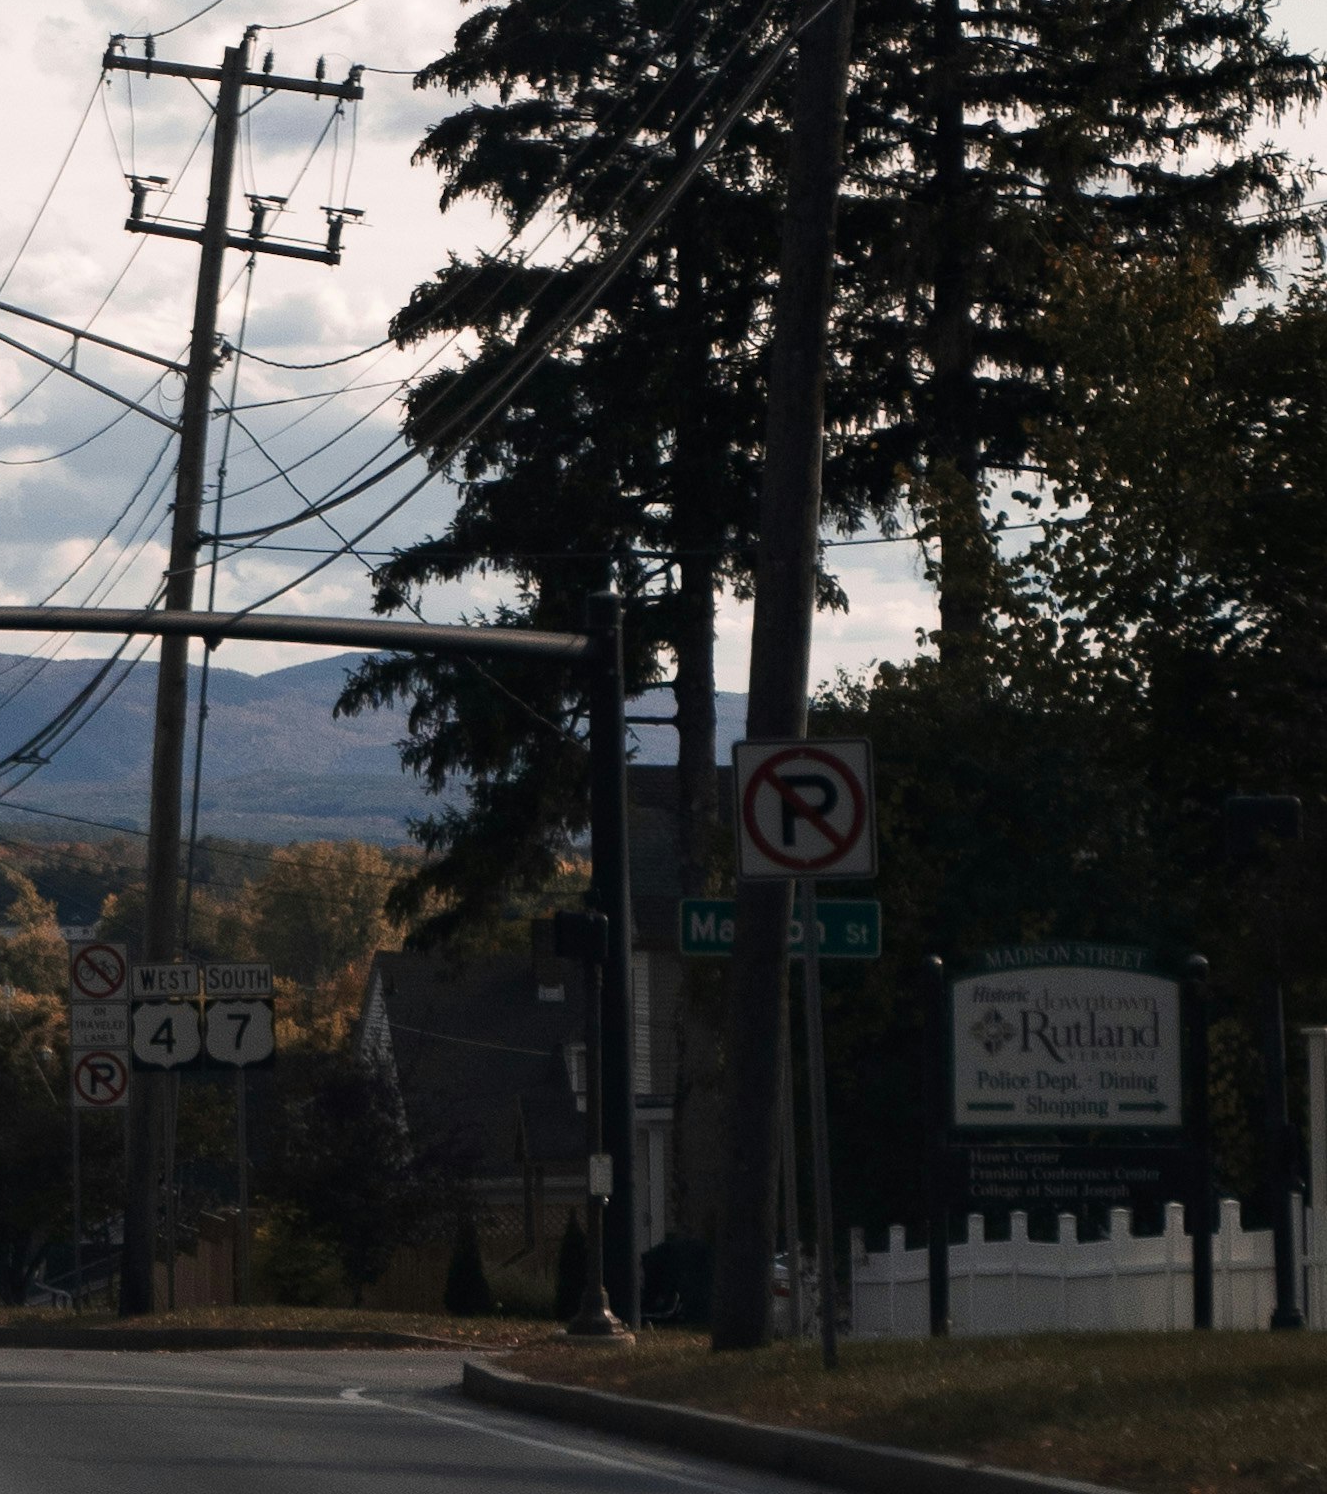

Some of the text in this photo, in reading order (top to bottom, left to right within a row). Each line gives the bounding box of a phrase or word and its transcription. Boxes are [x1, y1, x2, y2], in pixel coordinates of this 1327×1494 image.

[845, 922, 870, 944] St
[985, 945, 1146, 967] MADISON STREET
[140, 968, 192, 991] WEST
[207, 967, 269, 990] SOUTH
[972, 985, 1030, 1004] Historic
[1034, 989, 1157, 1012] downtown
[150, 1017, 176, 1054] 4
[227, 1013, 252, 1050] 7
[1020, 1010, 1160, 1063] Rutland
[976, 1070, 1158, 1092] Police Dept. Dining
[1025, 1097, 1109, 1117] Shopping
[969, 1150, 1060, 1164] Howe Center
[969, 1166, 1161, 1182] Franklin Conference Center
[969, 1183, 1131, 1200] College of Saint Joseph
